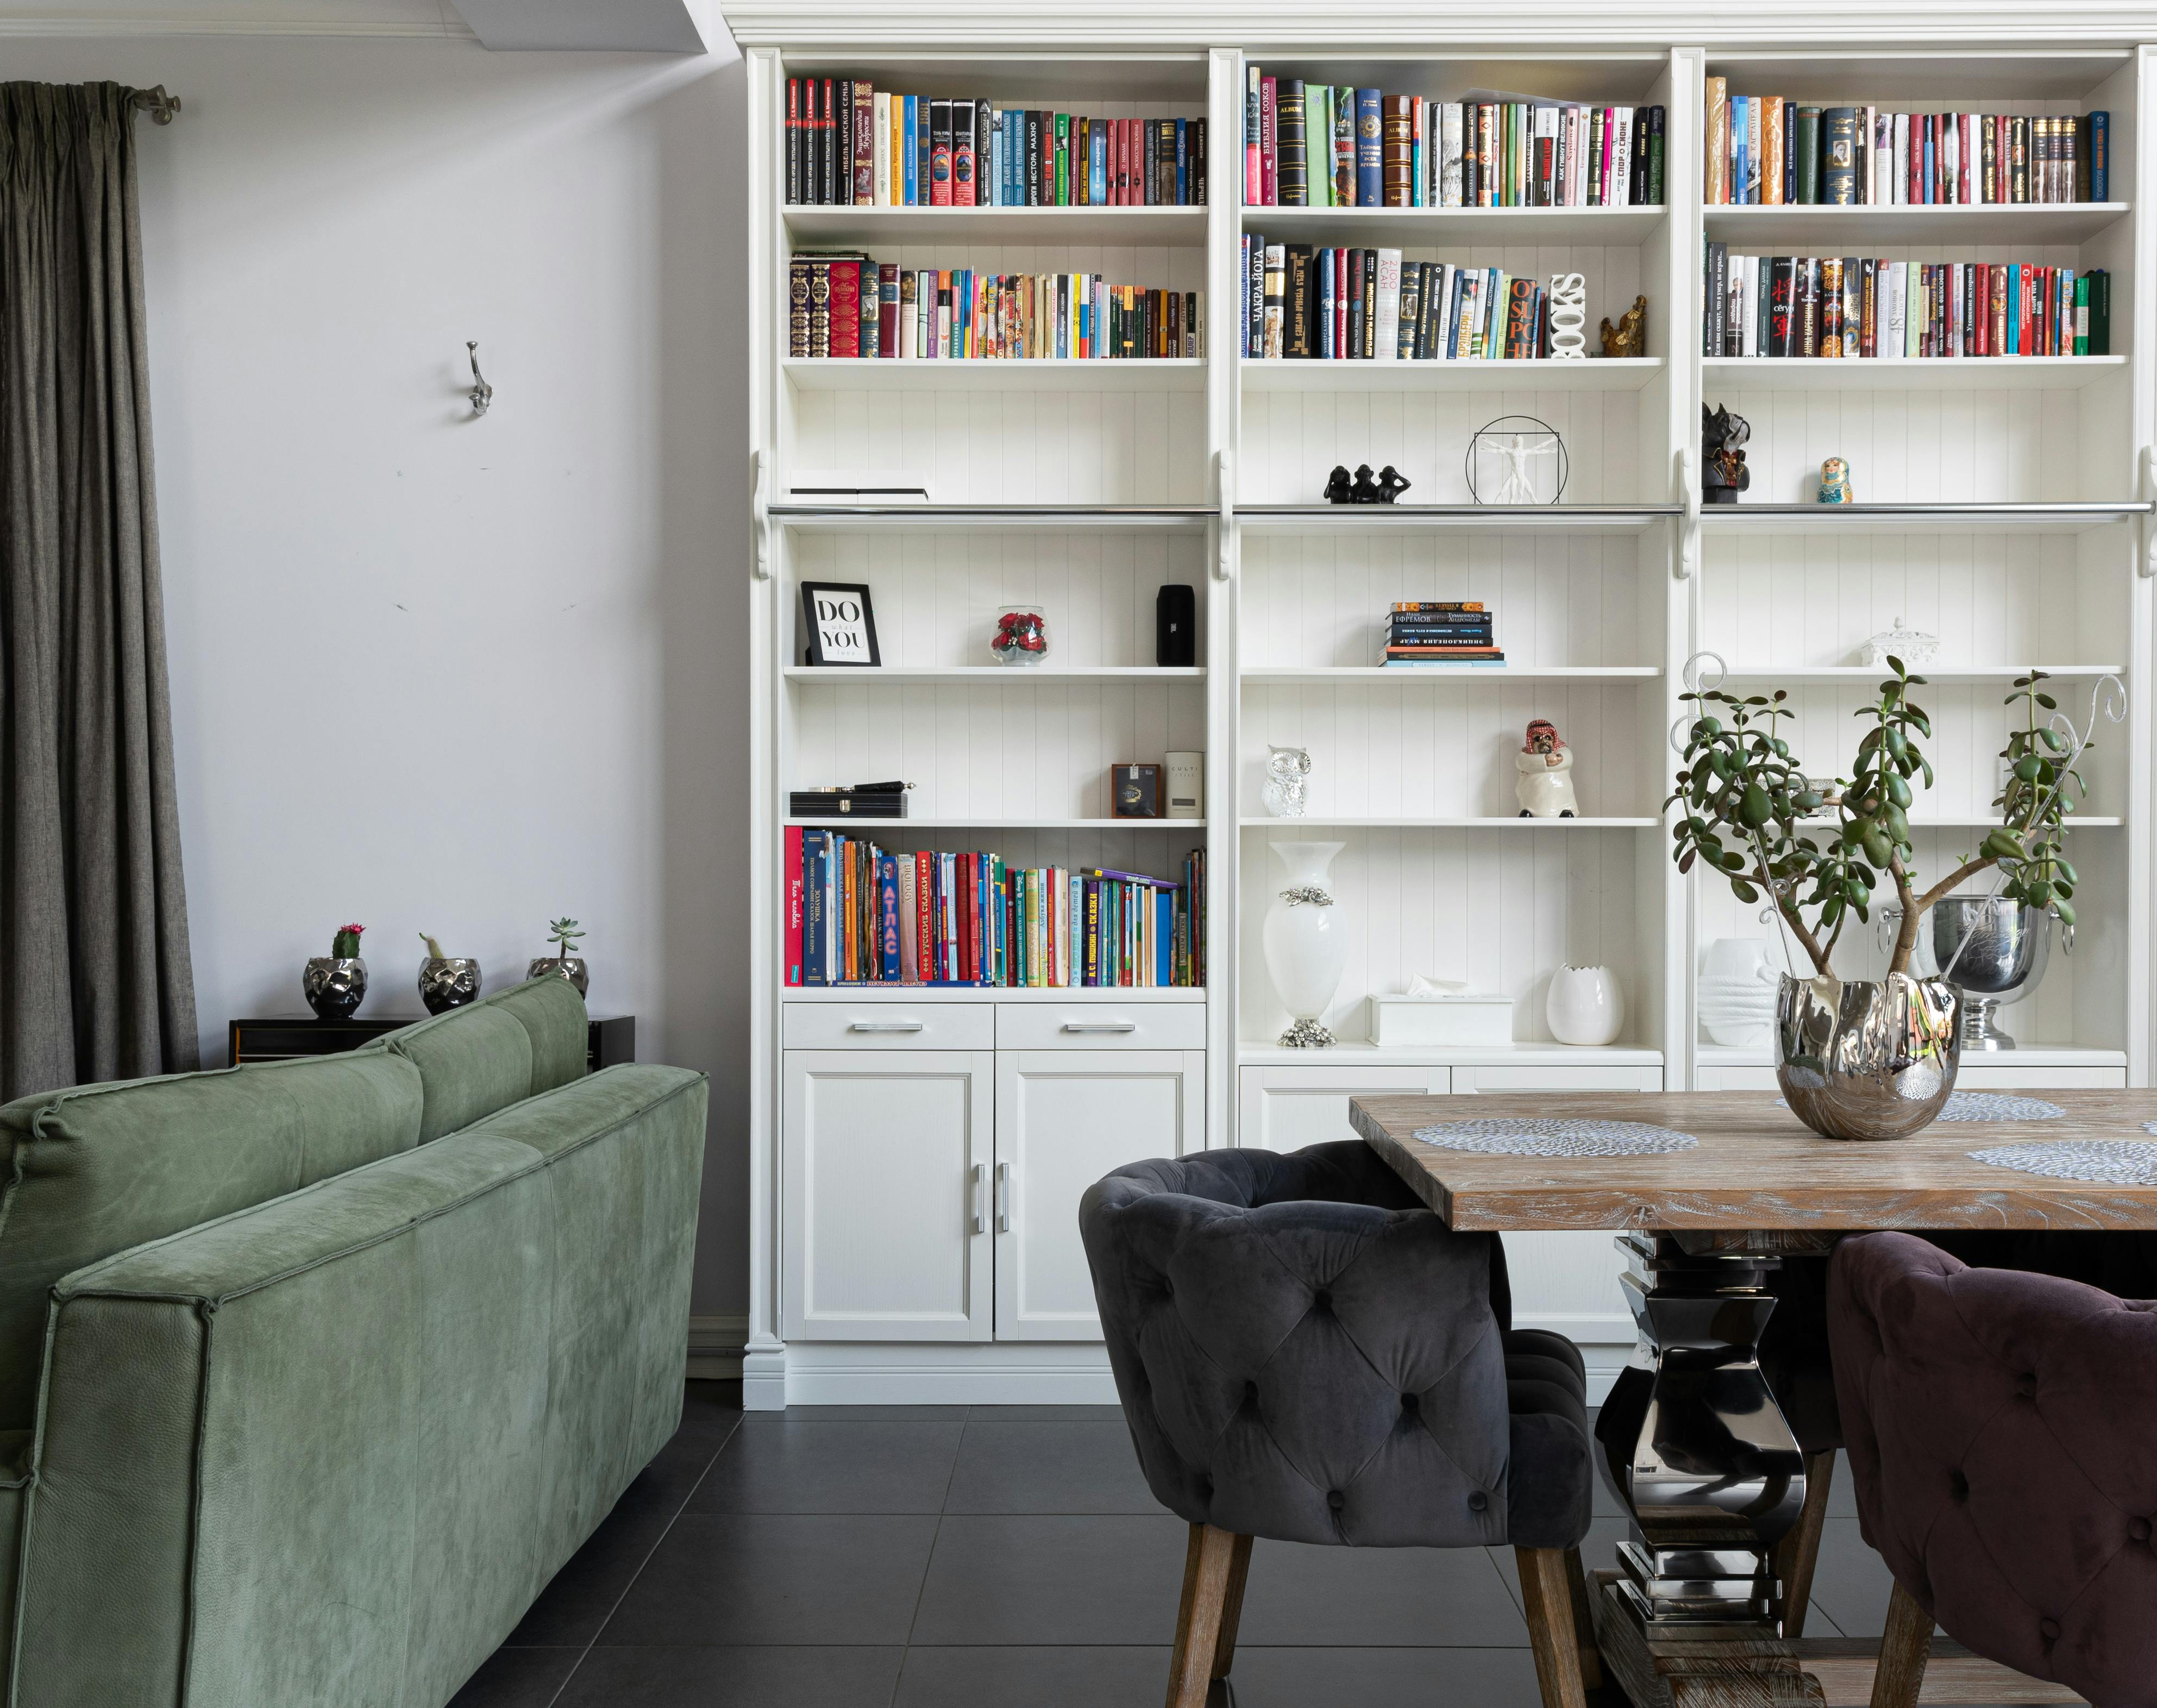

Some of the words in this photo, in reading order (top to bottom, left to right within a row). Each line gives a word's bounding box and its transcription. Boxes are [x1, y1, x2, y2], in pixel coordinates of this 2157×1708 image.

[1652, 156, 1661, 173] ВИДЫ
[1252, 250, 1263, 322] ЧАКРА-ЙОГА
[1804, 304, 1813, 335] КАРЕНИНА
[1890, 318, 1904, 334] 48
[1458, 315, 1472, 356] БРЭДБЕРИ
[1804, 337, 1813, 354] АННА
[816, 600, 860, 622] DO
[822, 632, 865, 648] YOU
